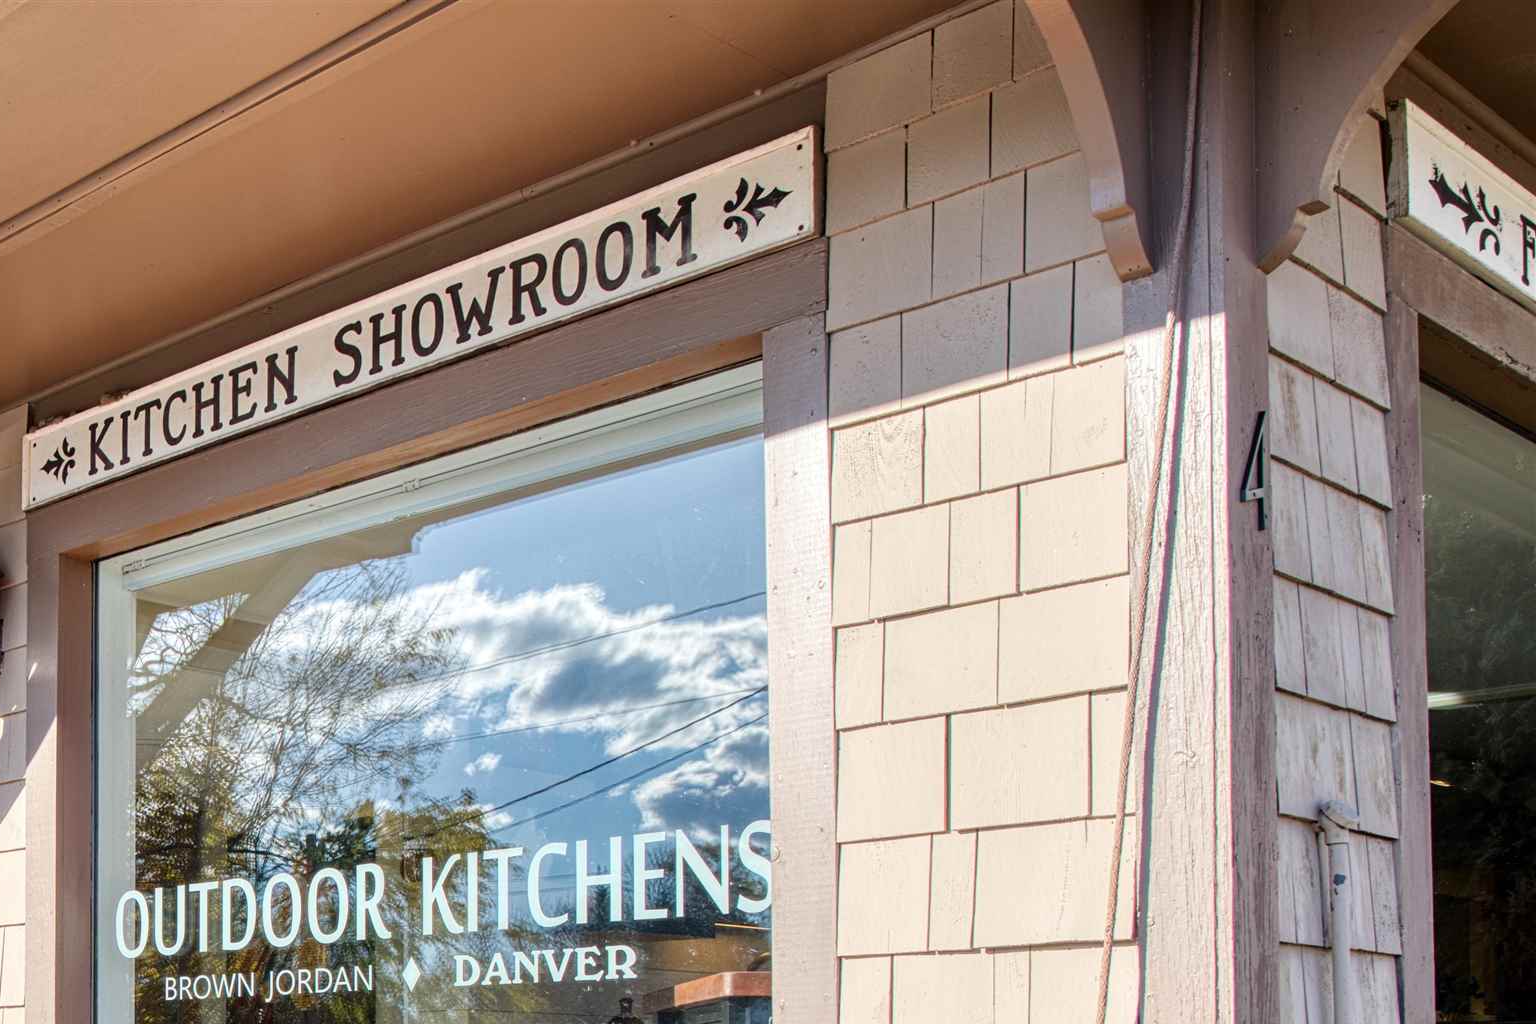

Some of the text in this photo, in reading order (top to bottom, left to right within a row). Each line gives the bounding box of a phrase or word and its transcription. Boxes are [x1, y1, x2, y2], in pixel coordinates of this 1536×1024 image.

[88, 192, 698, 477] KITCHEN SHOWROOM
[1240, 410, 1265, 531] 4
[115, 819, 773, 959] OUTDOOR KITCHENS
[164, 964, 374, 1003] BROWN JORDAN
[453, 944, 638, 988] DANVER
